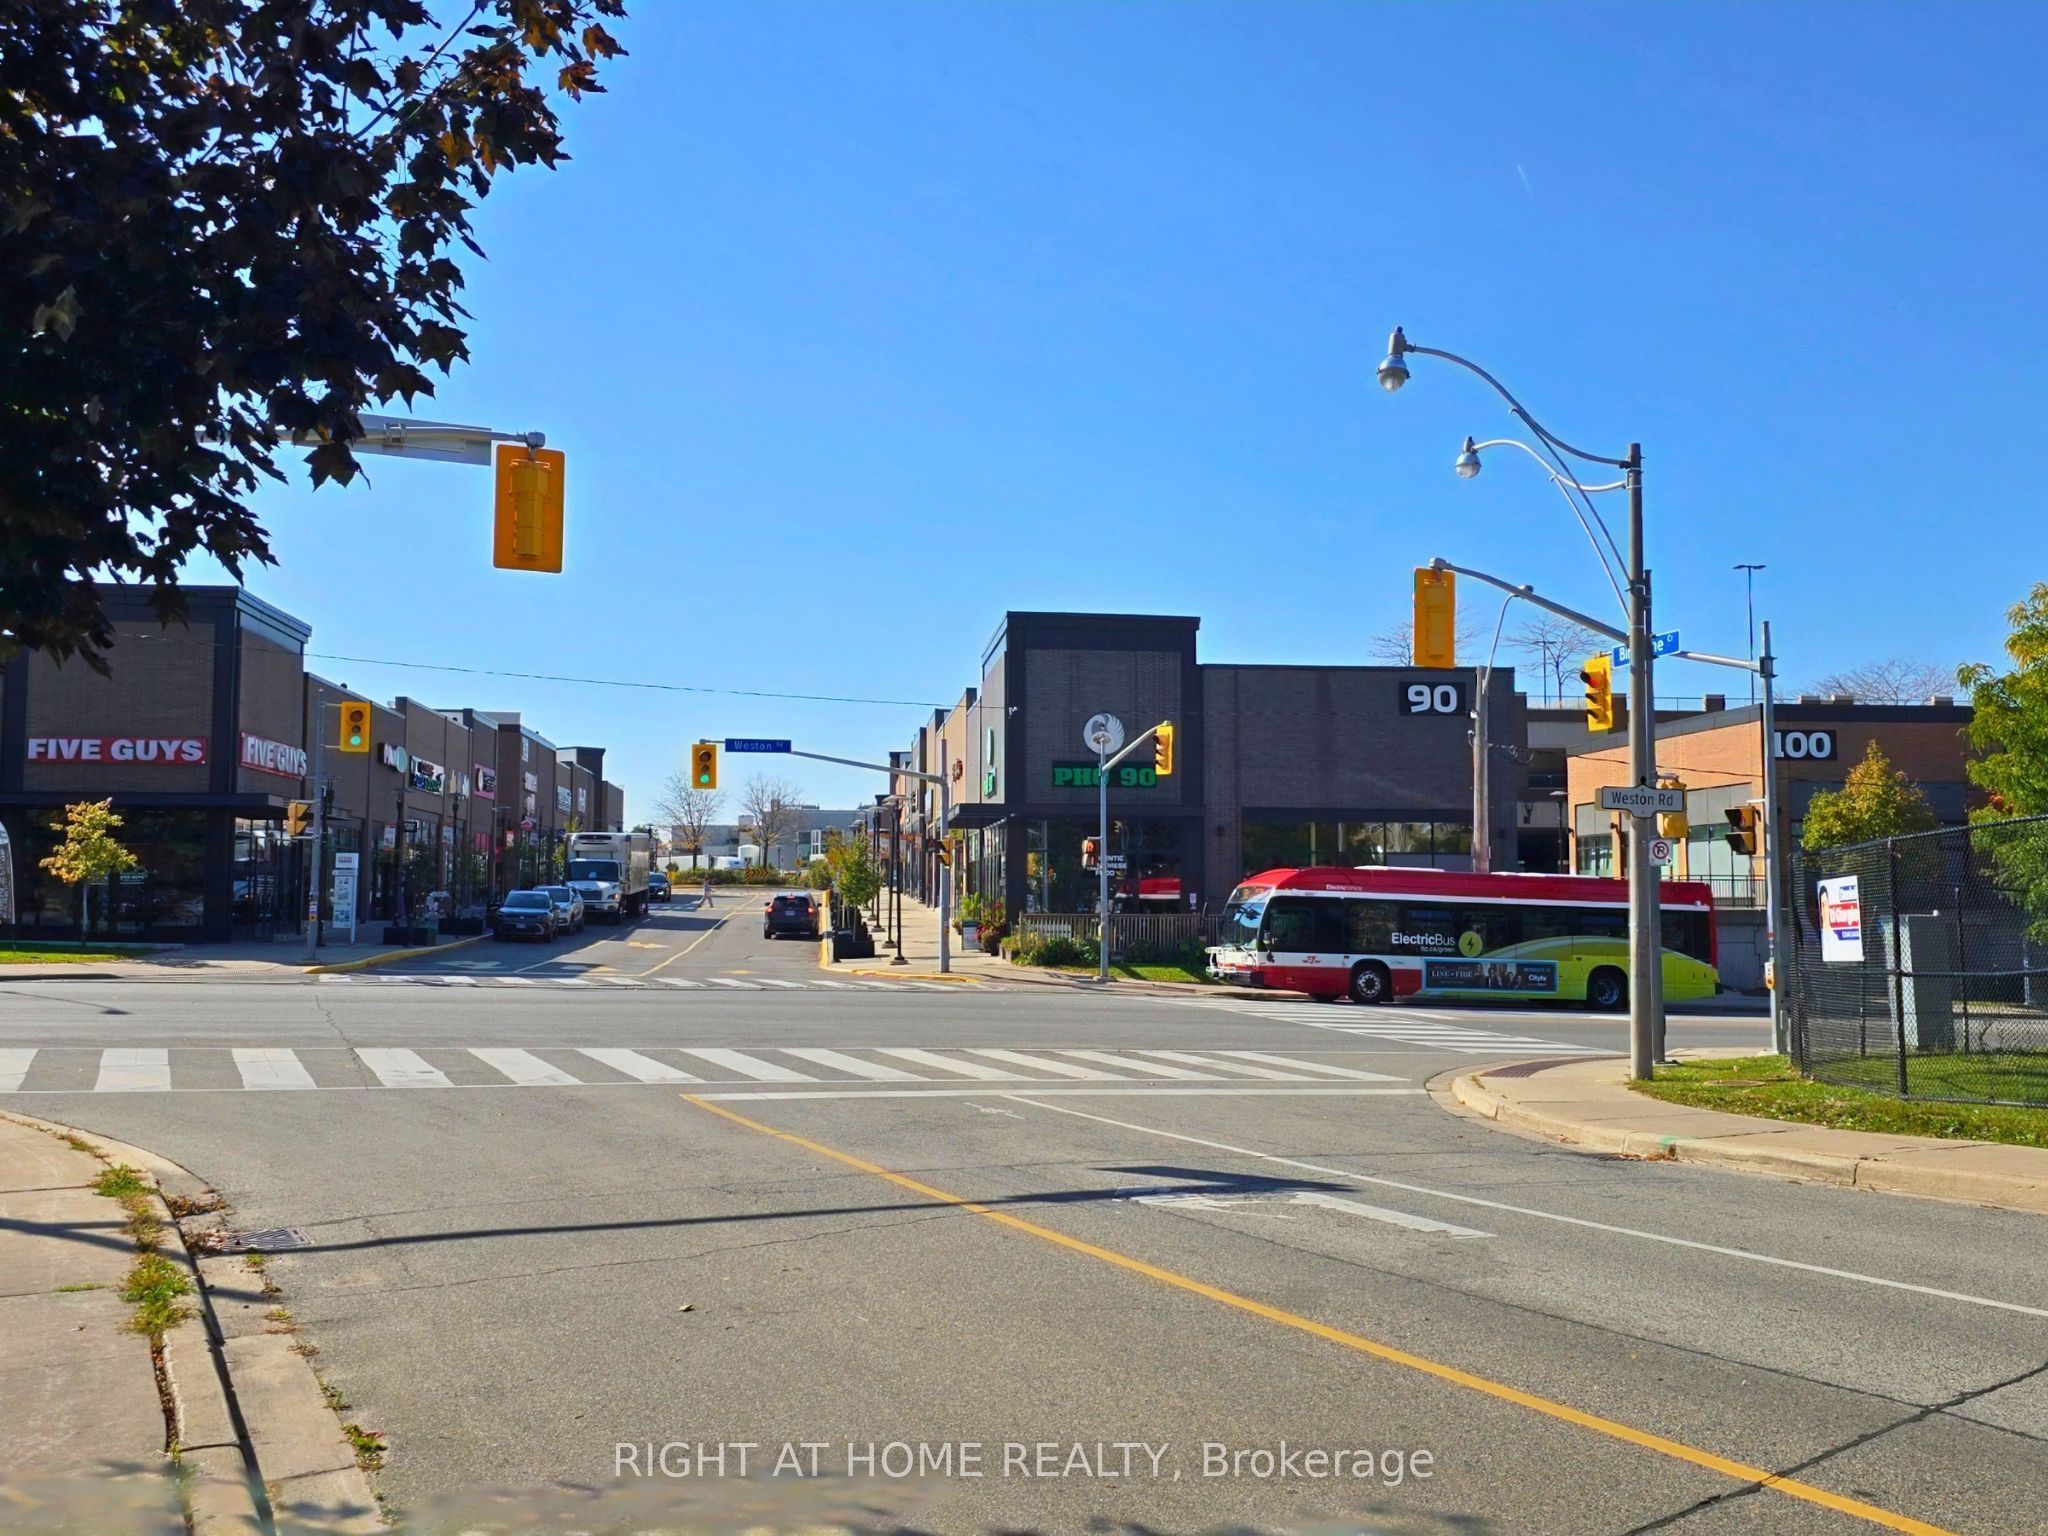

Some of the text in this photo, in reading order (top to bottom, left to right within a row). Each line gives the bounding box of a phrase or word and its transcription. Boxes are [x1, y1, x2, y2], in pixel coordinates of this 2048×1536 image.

[1407, 684, 1458, 713] 90
[27, 738, 203, 761] FIVE GUYS
[734, 740, 772, 751] Weston
[1773, 731, 1832, 758] 100
[247, 736, 307, 777] FIVE GUYS
[1119, 767, 1156, 787] 90
[1611, 791, 1674, 807] Weston Rd
[1391, 931, 1456, 948] ElectricBus
